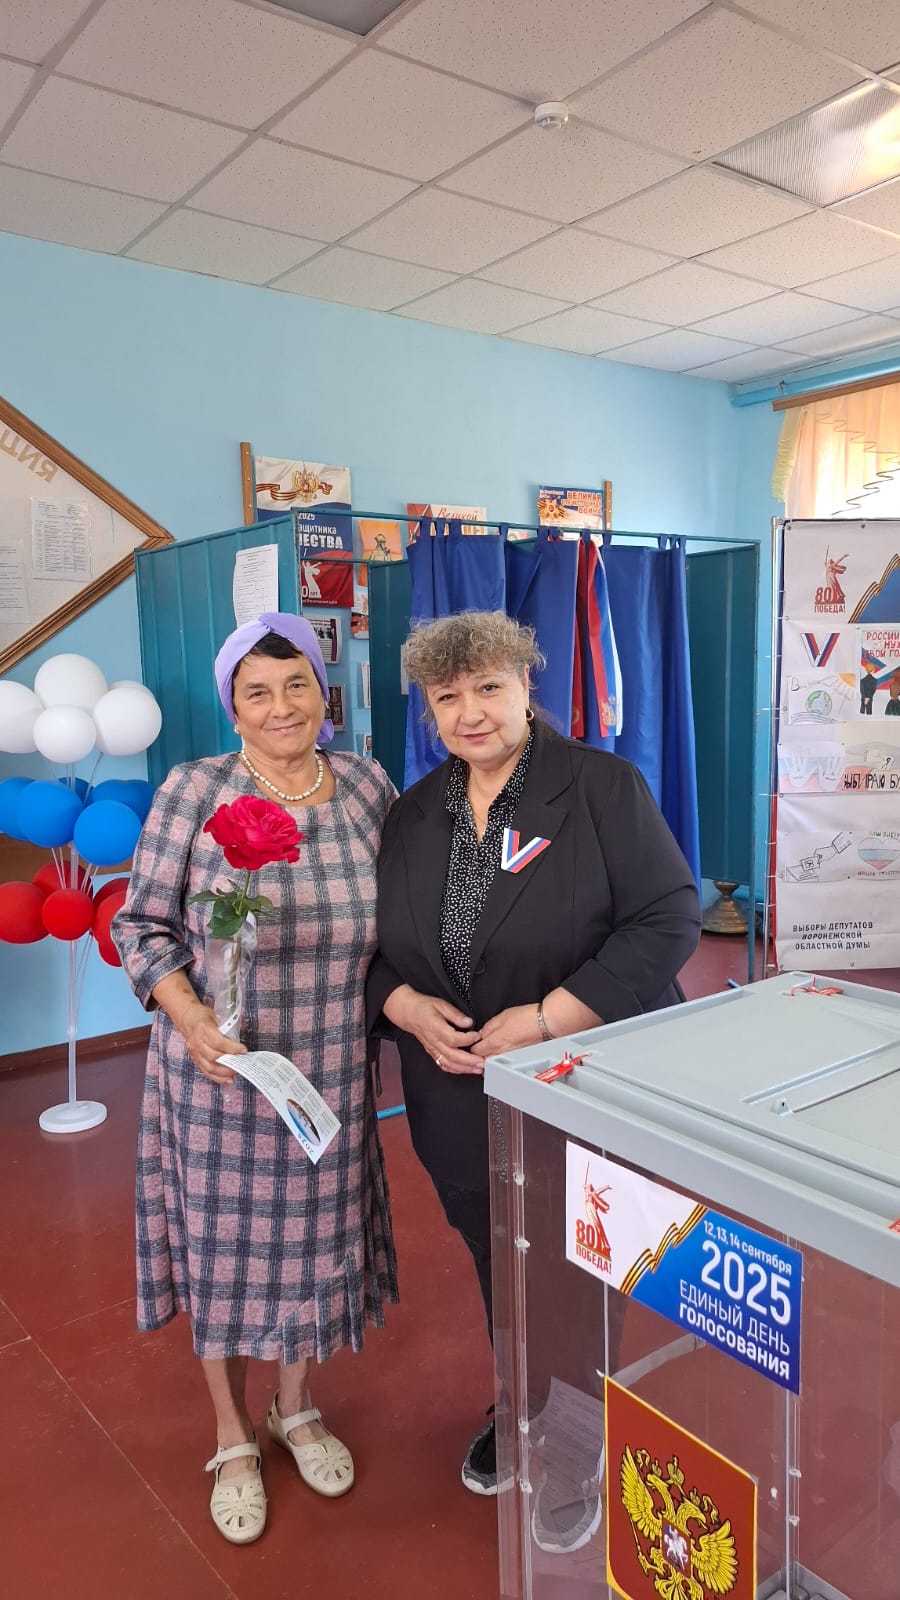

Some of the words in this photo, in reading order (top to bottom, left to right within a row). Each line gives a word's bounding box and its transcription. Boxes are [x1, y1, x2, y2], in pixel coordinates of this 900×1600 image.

[815, 587, 832, 602] 80
[815, 604, 845, 614] ПОБЕДА!
[866, 631, 900, 641] РОССИИ
[792, 923, 827, 932] ВЫБОРЫ
[828, 921, 873, 931] ДЕПУТАТОВ
[801, 930, 862, 940] ВОРОНЕЖСКОЙ
[795, 941, 843, 950] ОБЛАСТНОЙ
[846, 941, 870, 950] ДУМЫ
[576, 1219, 595, 1249] 80
[576, 1244, 612, 1275] ПОБЕДА!
[741, 1241, 793, 1277] сентября
[701, 1239, 792, 1326] 2025
[680, 1279, 743, 1331] ЕДИНЫЙ
[746, 1316, 790, 1356] ДЕНЬ
